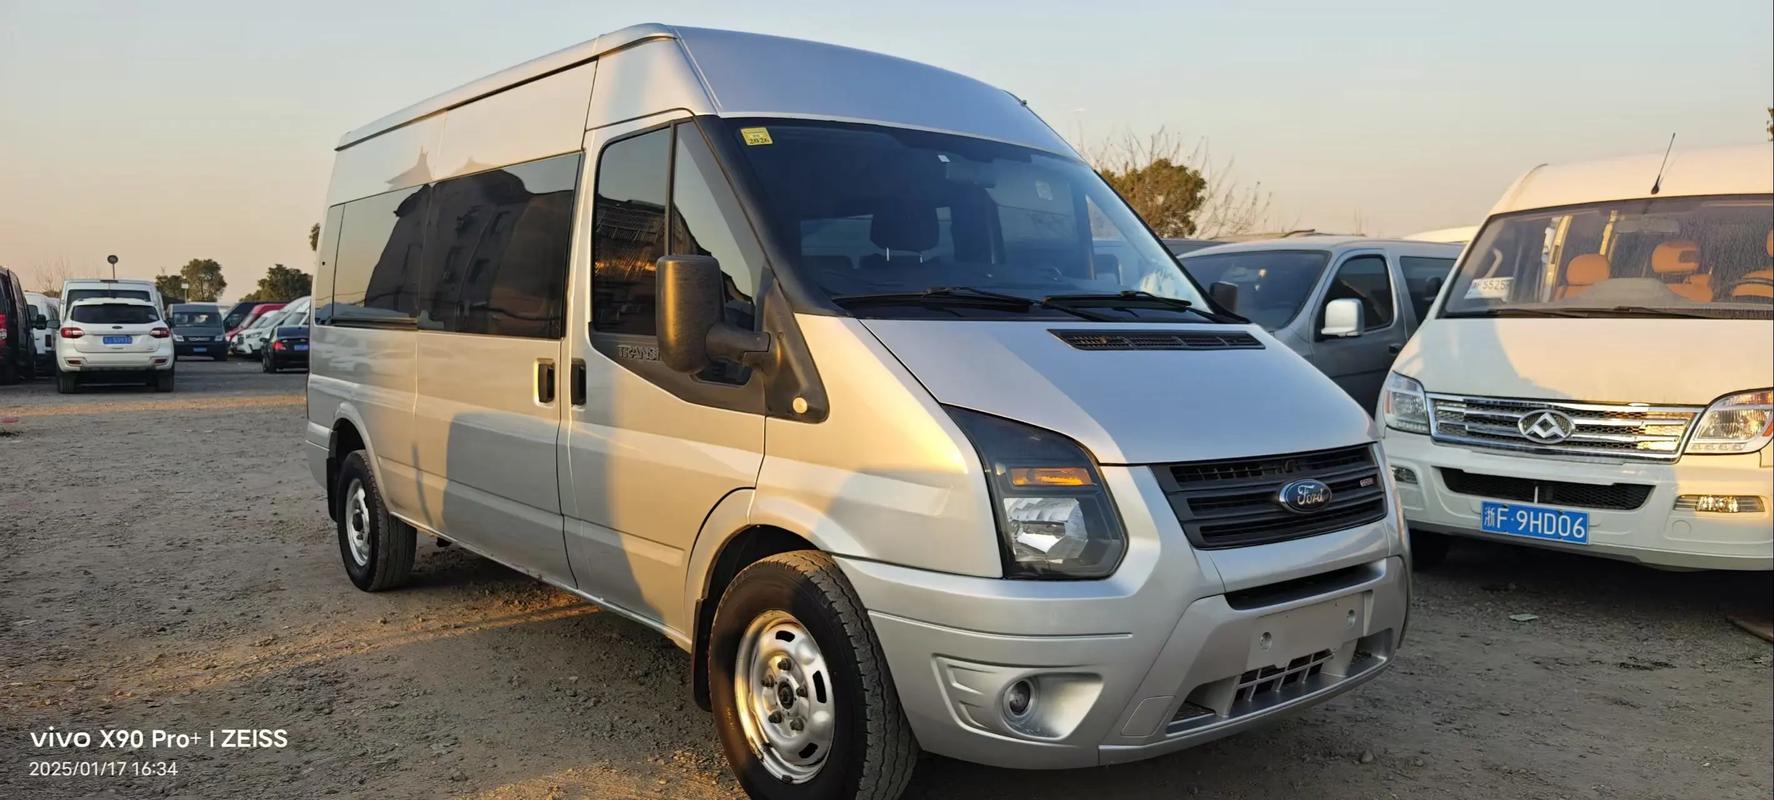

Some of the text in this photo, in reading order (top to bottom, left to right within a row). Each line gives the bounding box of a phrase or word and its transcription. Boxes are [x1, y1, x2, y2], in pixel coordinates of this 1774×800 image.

[617, 344, 661, 361] TRANSI
[1297, 484, 1325, 505] Ford
[1484, 506, 1585, 538] 浙F·9HD06
